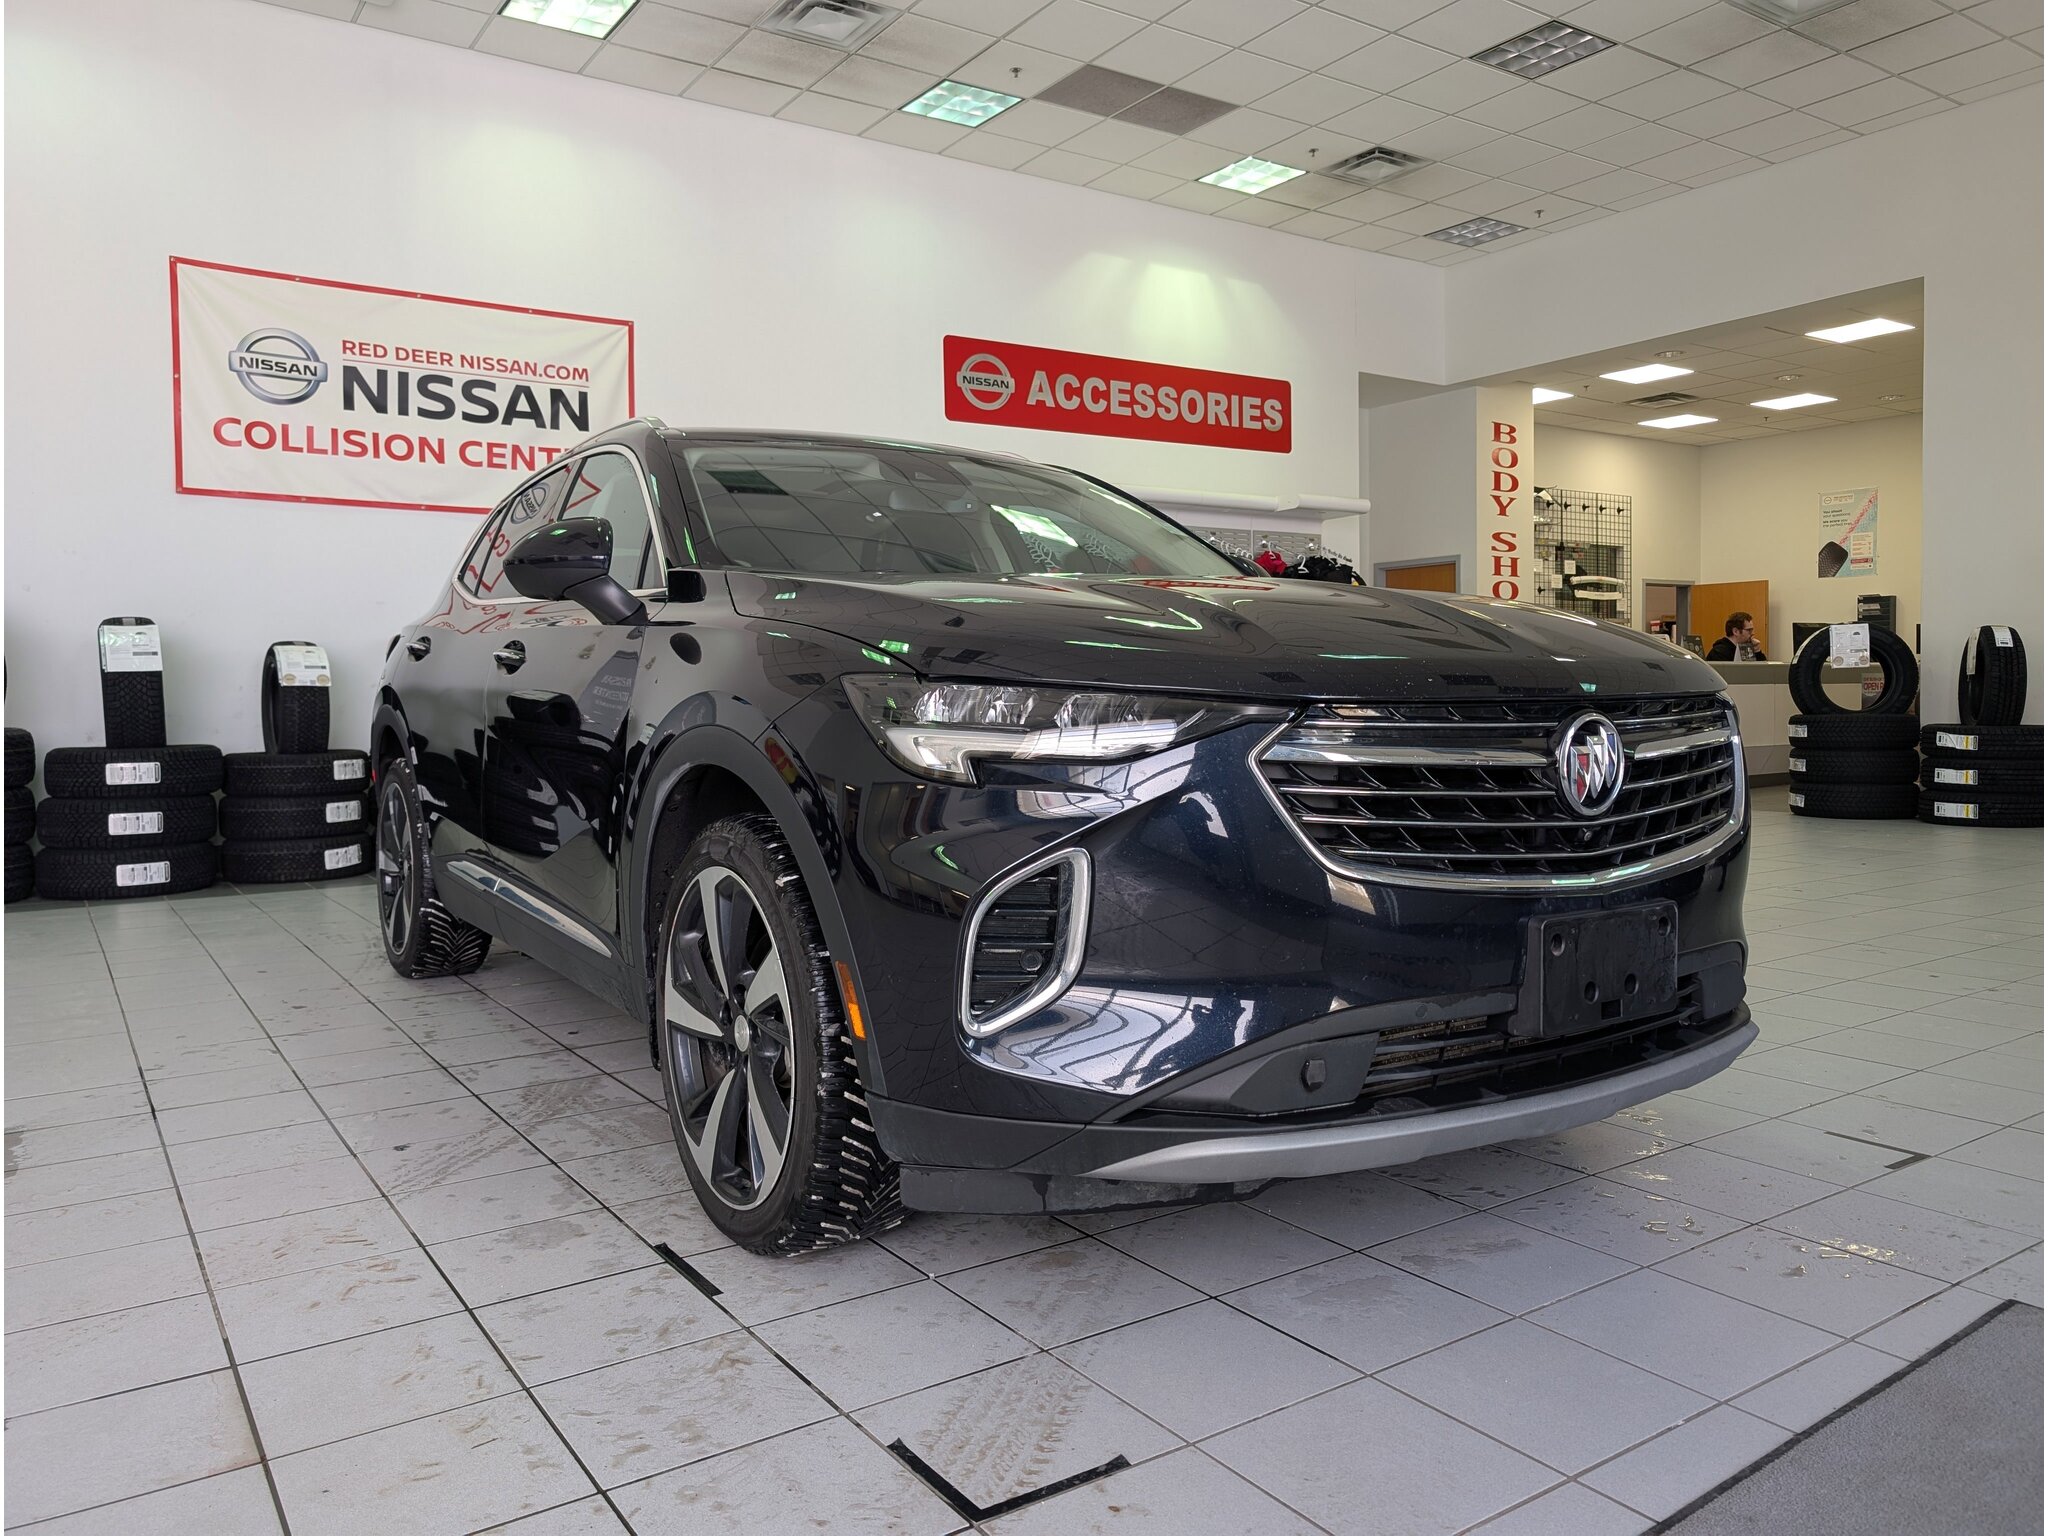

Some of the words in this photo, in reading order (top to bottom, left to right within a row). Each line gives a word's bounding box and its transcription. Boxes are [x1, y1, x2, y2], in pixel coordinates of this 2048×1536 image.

[239, 356, 318, 378] NISSAN
[342, 339, 388, 359] RED
[395, 347, 453, 367] DEER
[459, 354, 590, 382] NISSAN.COM
[962, 374, 1010, 390] NISSAN
[342, 365, 590, 432] NISSAN
[1026, 370, 1283, 431] ACCESSORIES
[212, 416, 446, 464] COLLISION
[458, 439, 574, 472] CENT
[1490, 421, 1520, 517] BODY
